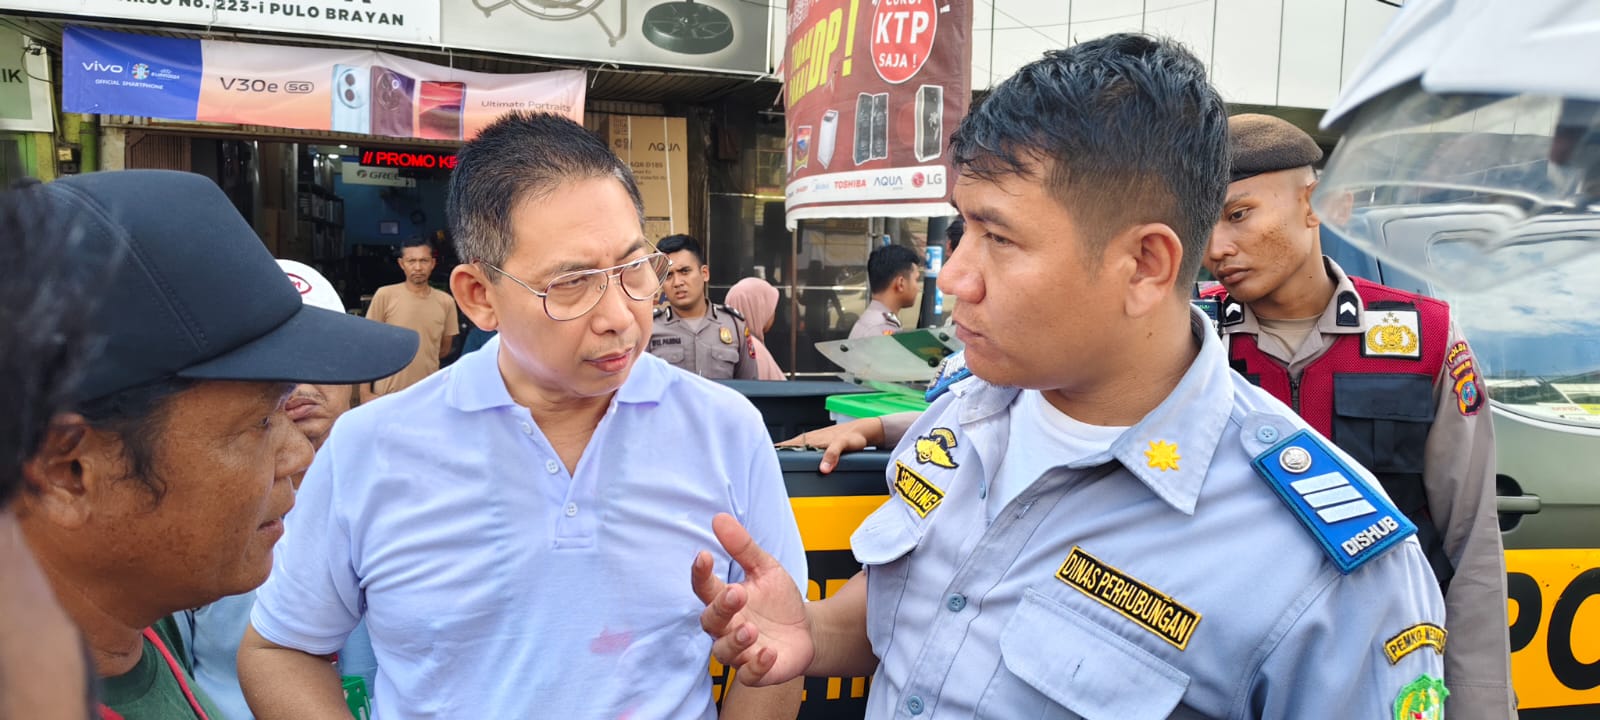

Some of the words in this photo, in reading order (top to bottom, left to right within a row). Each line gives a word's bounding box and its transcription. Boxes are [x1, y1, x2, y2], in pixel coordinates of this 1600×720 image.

[270, 3, 319, 18] PULO
[325, 8, 404, 26] BRAYAN
[875, 11, 929, 44] KTP
[82, 61, 123, 73] vivo
[879, 53, 908, 68] SAJA
[220, 76, 279, 93] V30e
[288, 83, 310, 92] 5G
[528, 101, 572, 112] Portraits
[375, 151, 436, 168] PROMO
[834, 179, 867, 189] TOSHIBA
[873, 176, 904, 186] AQUA
[927, 174, 943, 185] LG
[1341, 515, 1400, 557] DISHUB
[1062, 553, 1101, 590] DINAS
[1094, 571, 1193, 643] PERHUBUNGAN
[1389, 629, 1422, 657] PEMKO
